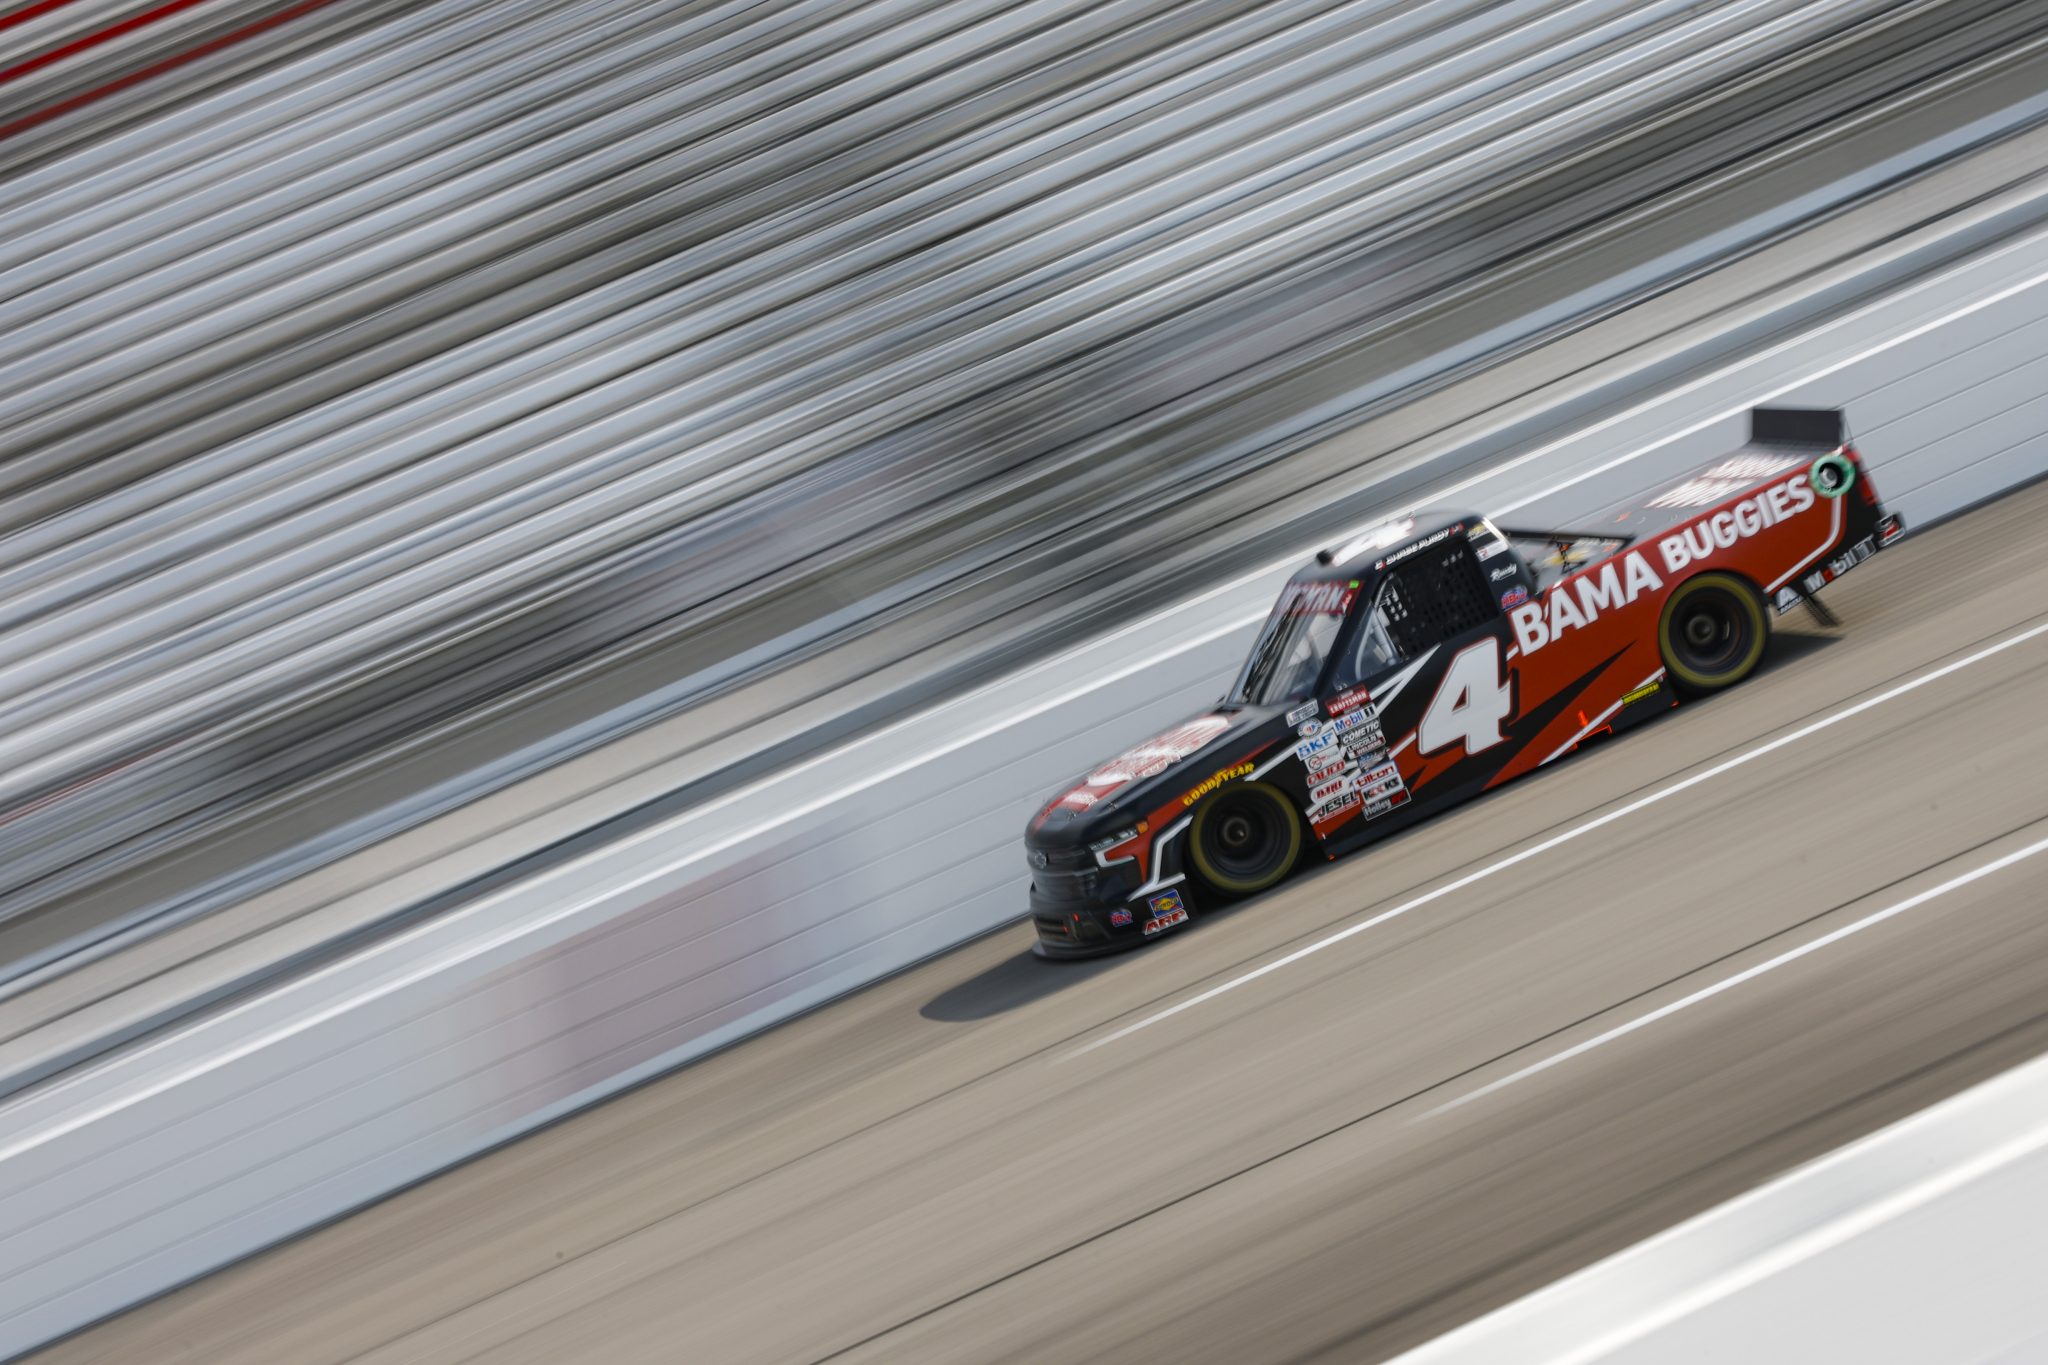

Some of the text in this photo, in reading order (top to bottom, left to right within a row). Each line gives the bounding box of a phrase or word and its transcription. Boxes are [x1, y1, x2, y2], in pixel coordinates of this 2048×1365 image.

[1510, 550, 1664, 656] BAMA
[1657, 473, 1816, 574] BUGGIES
[1329, 690, 1368, 714] CRAFTSMAN
[1416, 636, 1513, 757] 4
[1334, 711, 1364, 731] Mobil
[1342, 719, 1380, 743] COMETIC
[1298, 732, 1334, 757] SKF
[1347, 734, 1378, 753] LINCOLN
[1183, 763, 1255, 806] GOODYEAR
[1308, 761, 1346, 785] CALICO
[1356, 765, 1395, 787] tilton
[1318, 790, 1360, 817] JESEL
[1363, 798, 1392, 816] Holley
